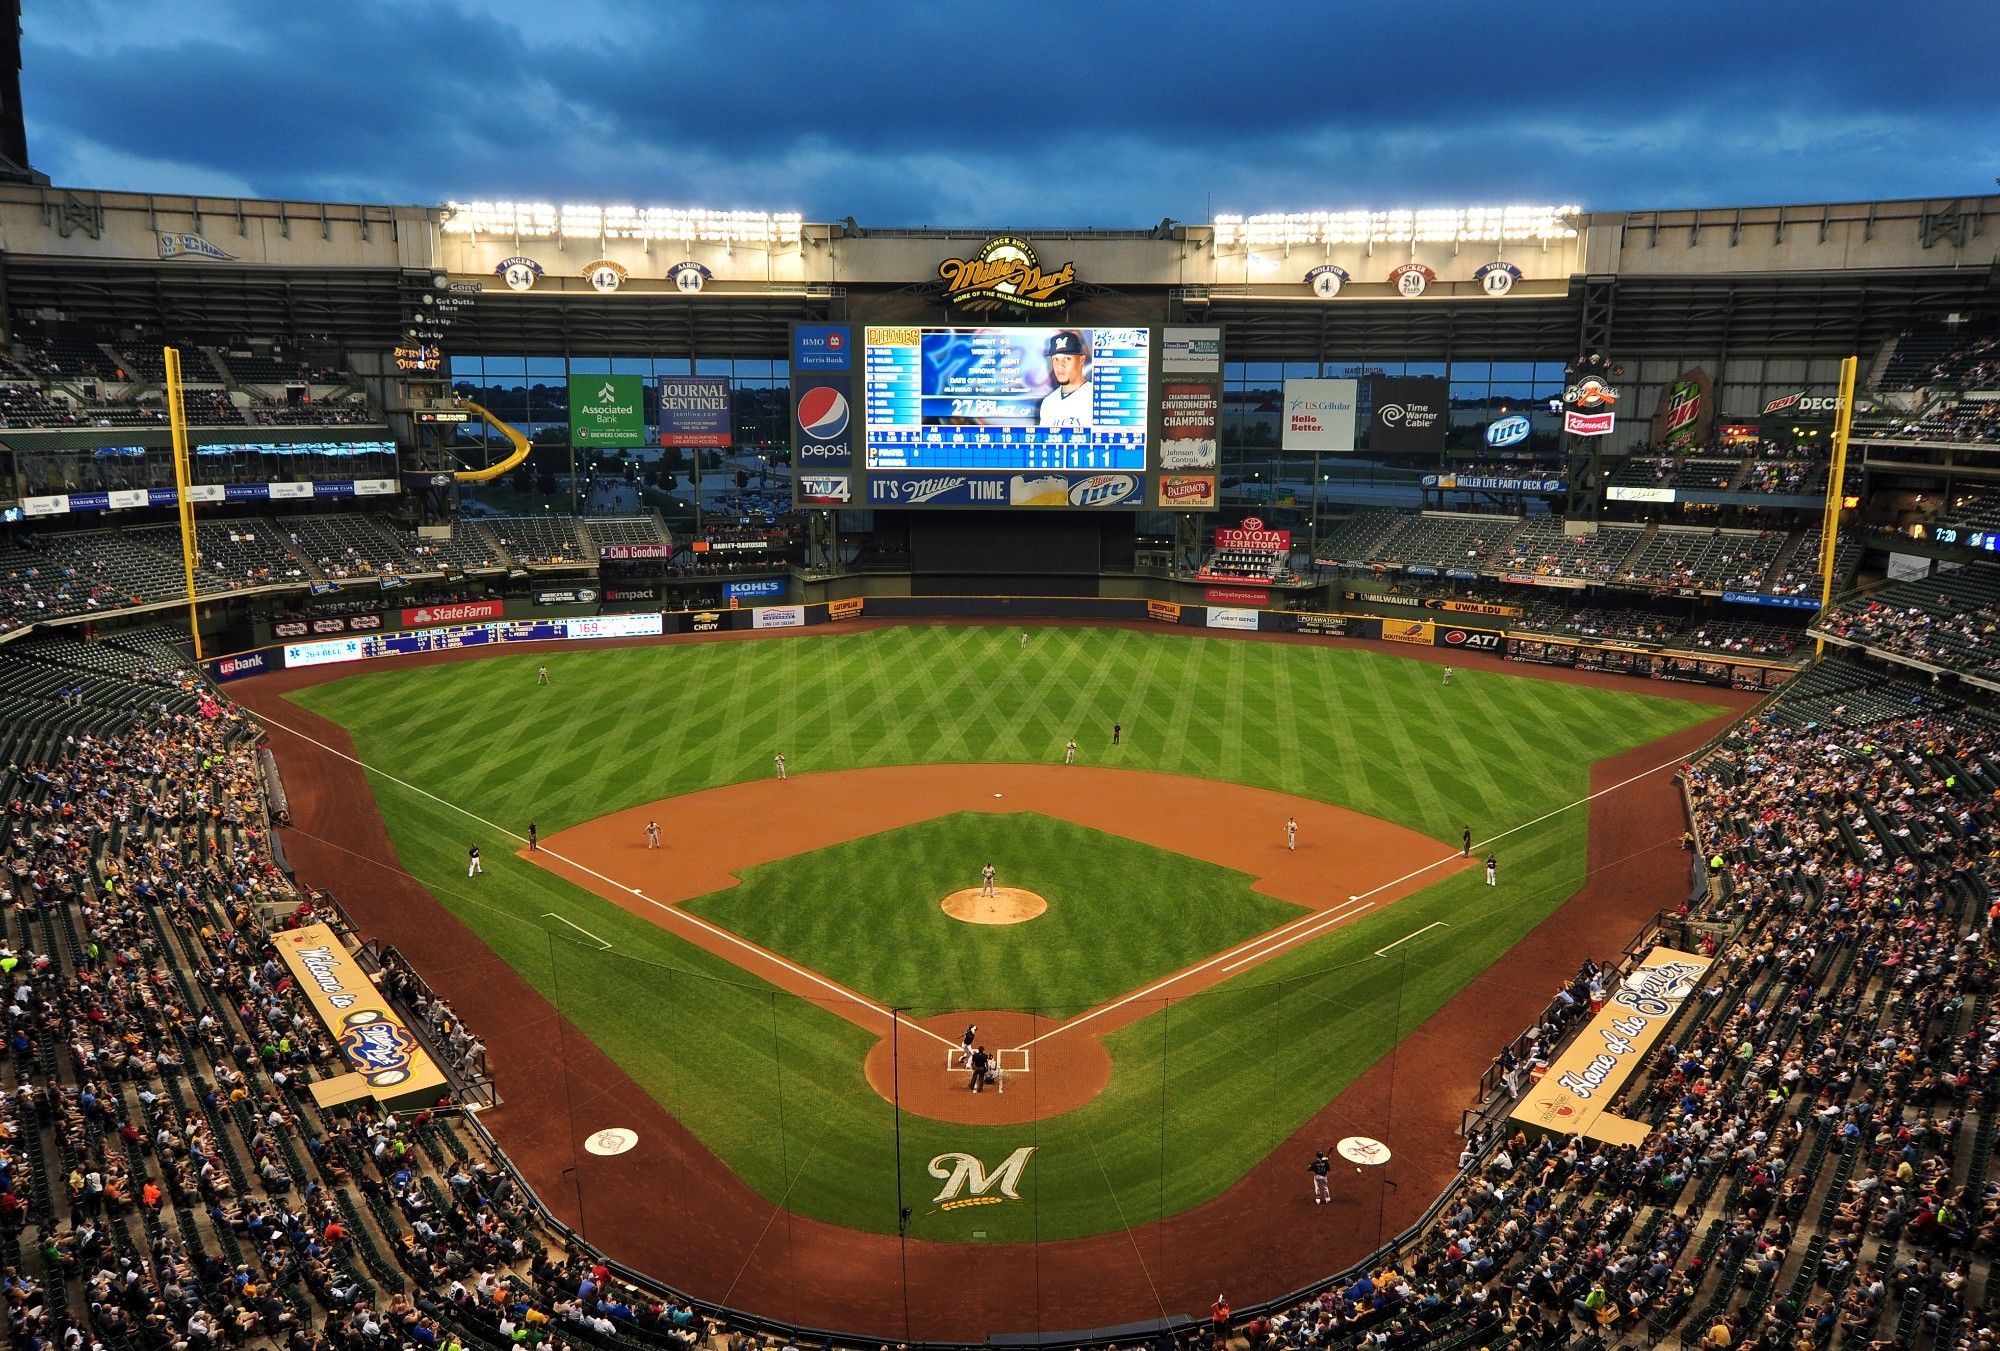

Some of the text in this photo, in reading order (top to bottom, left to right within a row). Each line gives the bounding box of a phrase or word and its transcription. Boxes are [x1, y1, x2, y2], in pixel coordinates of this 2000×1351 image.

[986, 238, 1029, 250] SINCE 2001
[503, 258, 536, 269] FINGERS
[678, 262, 701, 271] AARON
[1485, 262, 1512, 271] YOUNT
[1311, 265, 1344, 276] MOLITOR
[509, 270, 531, 286] 34
[595, 272, 616, 286] 42
[679, 274, 701, 288] 44
[940, 258, 1075, 299] Miller Park
[1404, 275, 1420, 287] 50
[1488, 276, 1508, 291] 19
[1319, 277, 1332, 292] 4
[953, 293, 972, 304] HOME
[996, 293, 1034, 307] MILWAUKEE
[1034, 299, 1067, 308] BREWERS
[802, 338, 824, 346] BMO
[803, 356, 844, 364] Harris Bank
[662, 385, 727, 398] JOURNAL
[582, 405, 633, 415] Associated
[662, 398, 728, 410] SENTINEL
[951, 399, 974, 417] 27
[1162, 400, 1218, 410] ENVIRONMENTS
[1318, 402, 1352, 410] Cellular
[1406, 404, 1428, 412] Time
[596, 414, 618, 424] Bank
[1164, 416, 1215, 426] CHAMPIONS
[1291, 415, 1317, 424] Hello
[1406, 412, 1438, 420] Warner
[1291, 424, 1324, 432] Better.
[1405, 420, 1430, 428] Cable
[1492, 422, 1527, 446] Lite
[801, 442, 847, 459] pepsi
[1167, 449, 1194, 458] Johnson
[1171, 456, 1199, 464] Controls
[1090, 475, 1116, 487] Miller
[1457, 476, 1542, 490] MILLER LITE PARTY DECK
[873, 476, 1006, 503] IT'S Miller TIME
[1078, 482, 1126, 506] Lite
[1167, 483, 1206, 497] PALERMO'S
[1224, 530, 1281, 542] TOYOTA
[1935, 528, 1957, 543] 7:20
[712, 541, 768, 550] HARLEY-DAVIDSON
[1224, 540, 1281, 550] TERRITORY
[610, 546, 668, 559] Club Goodwill
[730, 582, 778, 592] KOHL'S
[615, 589, 654, 601] impact
[1218, 591, 1266, 600] buyatoyota.com
[1735, 594, 1761, 604] Allstate
[1455, 602, 1501, 614] UWM.EDU
[580, 622, 598, 633] 169
[694, 624, 718, 632] CHEVY
[1384, 633, 1432, 645] SOUTHWEST.COM
[1466, 634, 1500, 647] ATI
[296, 945, 345, 994] Welcome
[328, 994, 357, 1009] to
[1613, 961, 1705, 1017] Brewers
[1557, 1015, 1648, 1099] Home of the
[928, 1146, 1039, 1204] M
